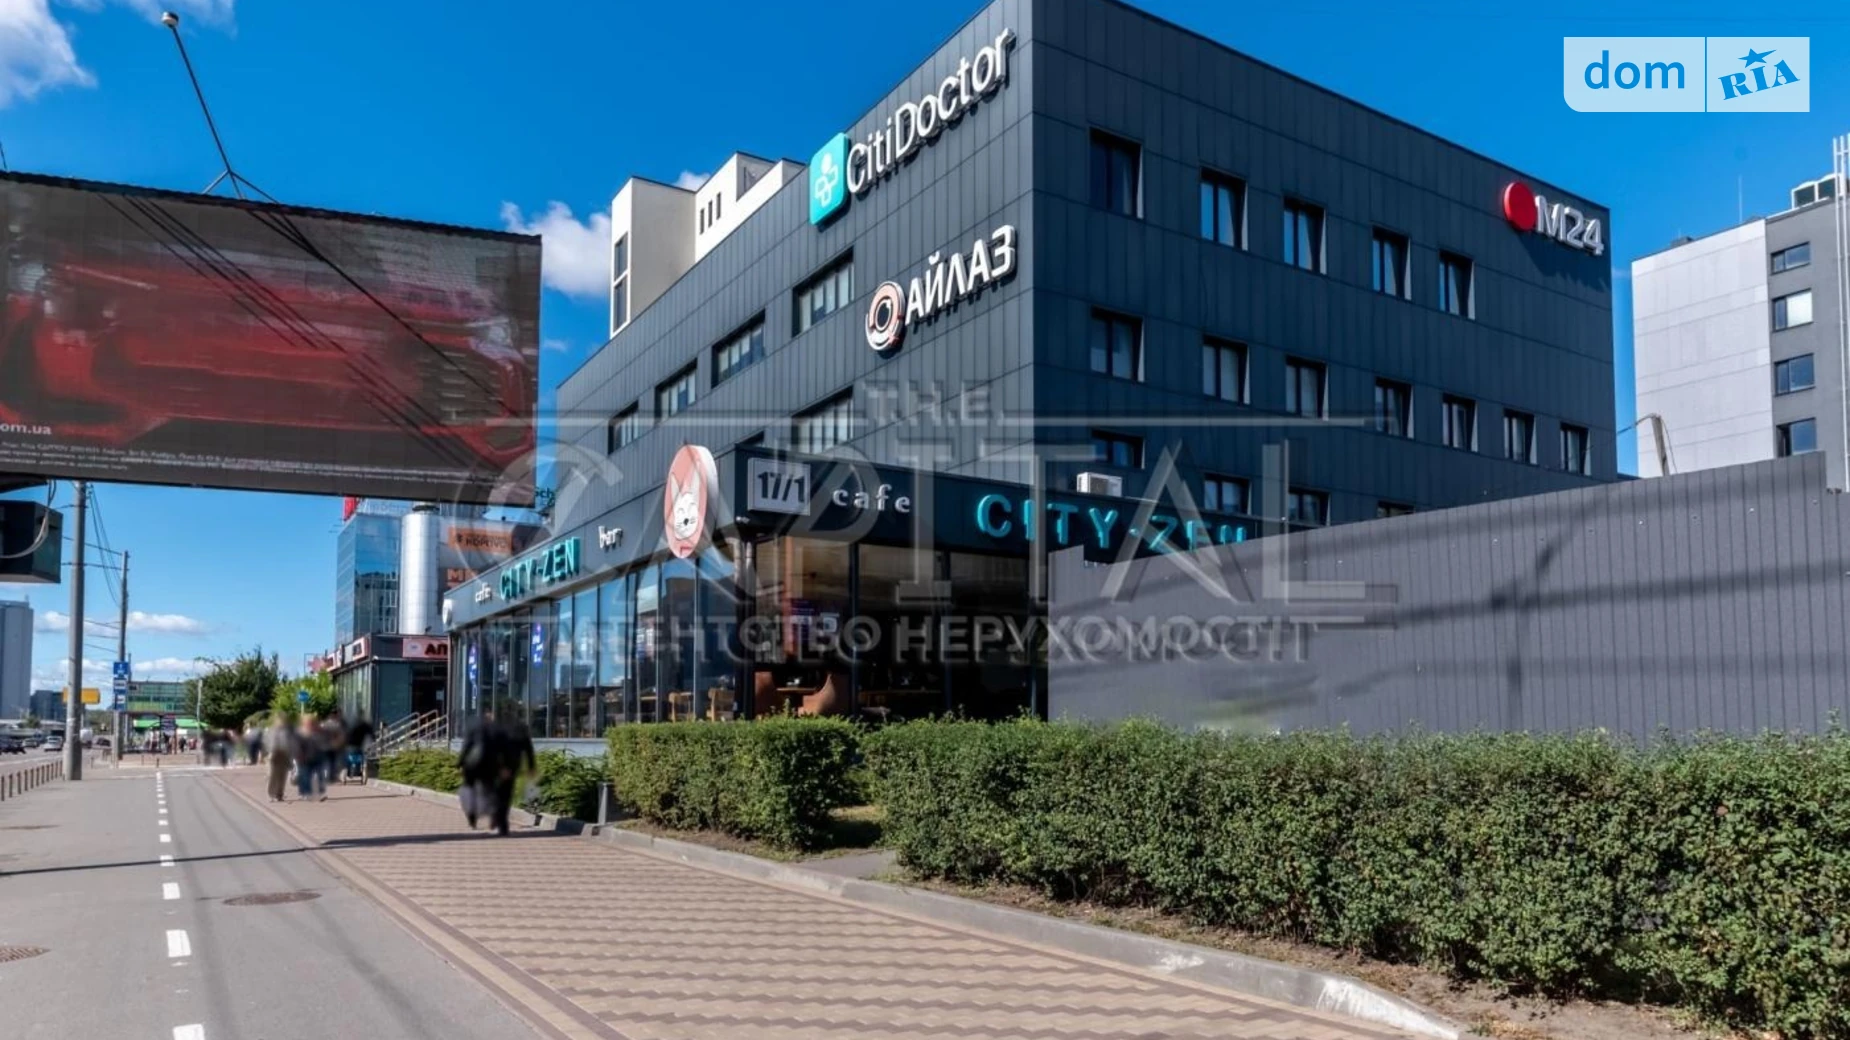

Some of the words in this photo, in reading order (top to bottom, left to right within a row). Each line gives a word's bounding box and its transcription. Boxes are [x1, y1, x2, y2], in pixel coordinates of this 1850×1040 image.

[847, 27, 1016, 194] CitiDoctor
[1535, 195, 1605, 256] M24
[905, 225, 1016, 325] АЙЛАЗ
[757, 470, 805, 503] 17/1
[832, 484, 911, 514] cafe
[500, 537, 580, 600] CITY-ZEN
